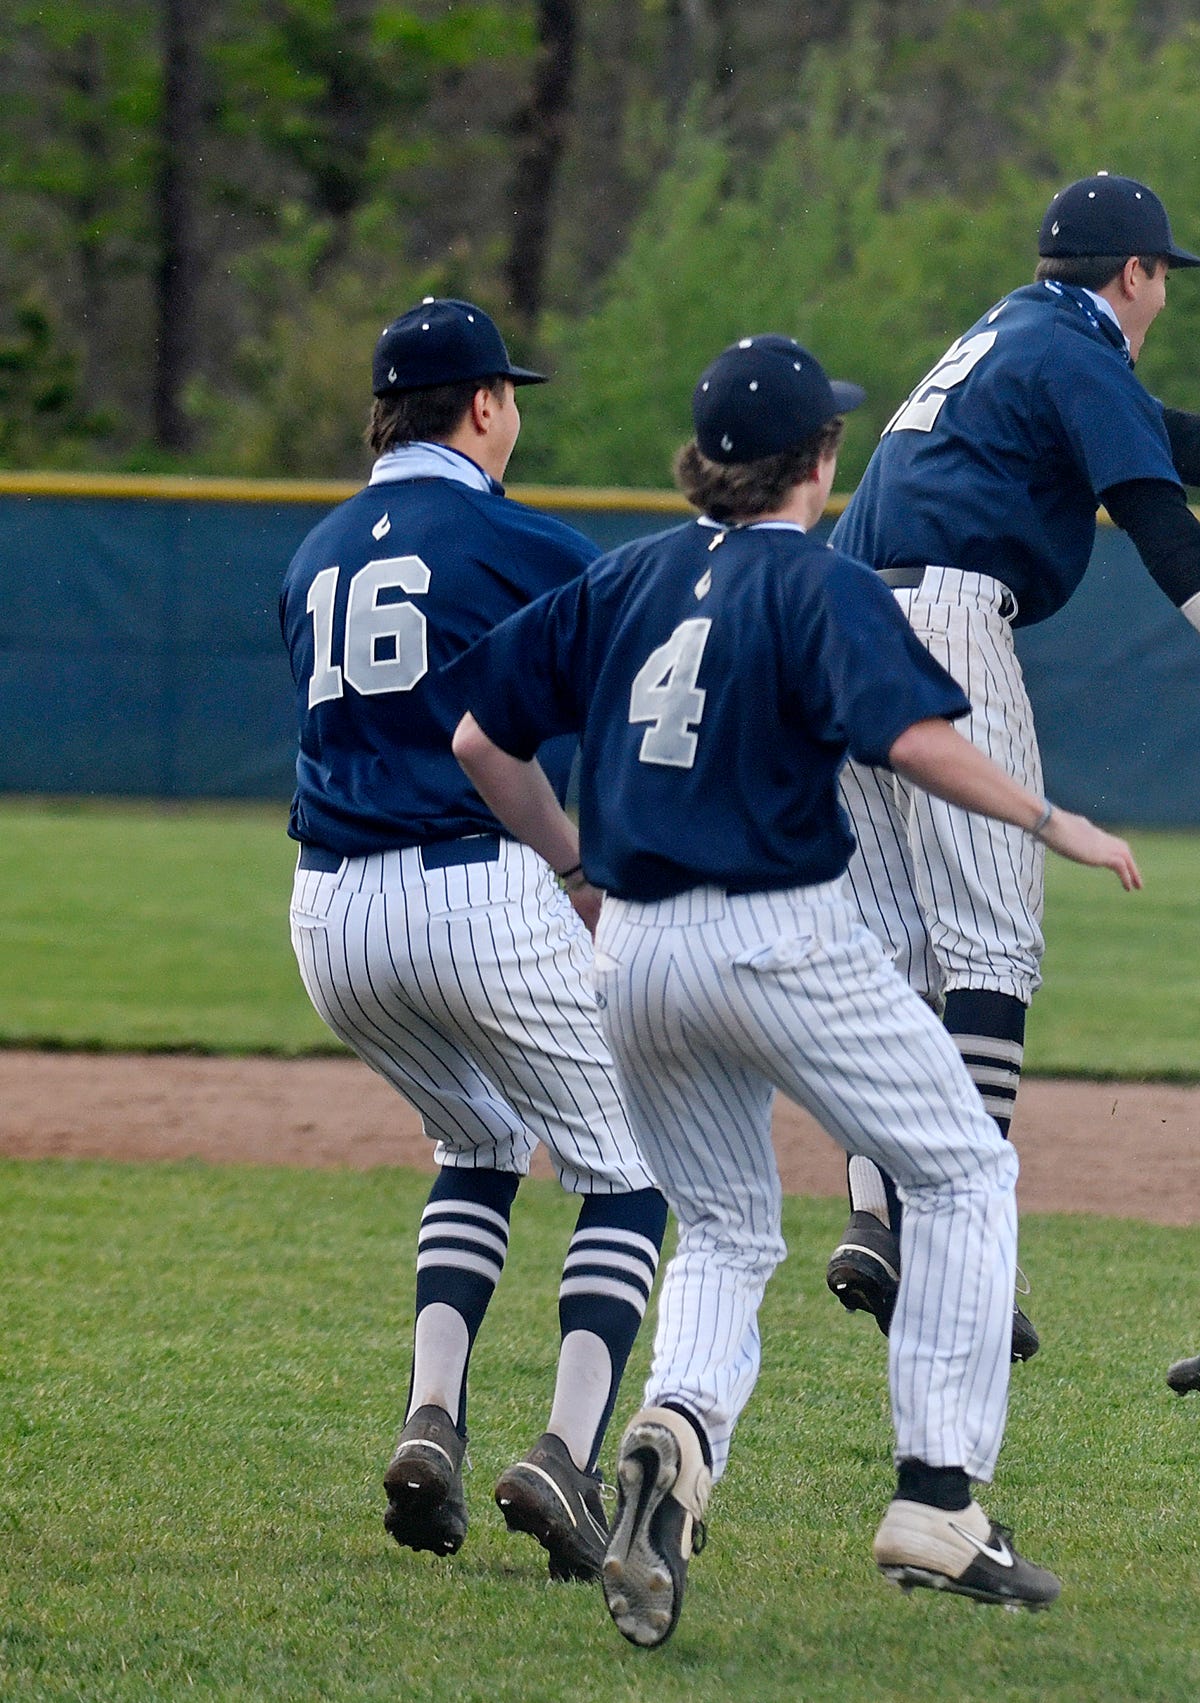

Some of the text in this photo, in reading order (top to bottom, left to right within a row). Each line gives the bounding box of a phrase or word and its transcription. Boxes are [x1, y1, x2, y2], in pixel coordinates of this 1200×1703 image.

[880, 330, 998, 439] 2
[306, 555, 431, 710] 16
[628, 617, 712, 769] 4
